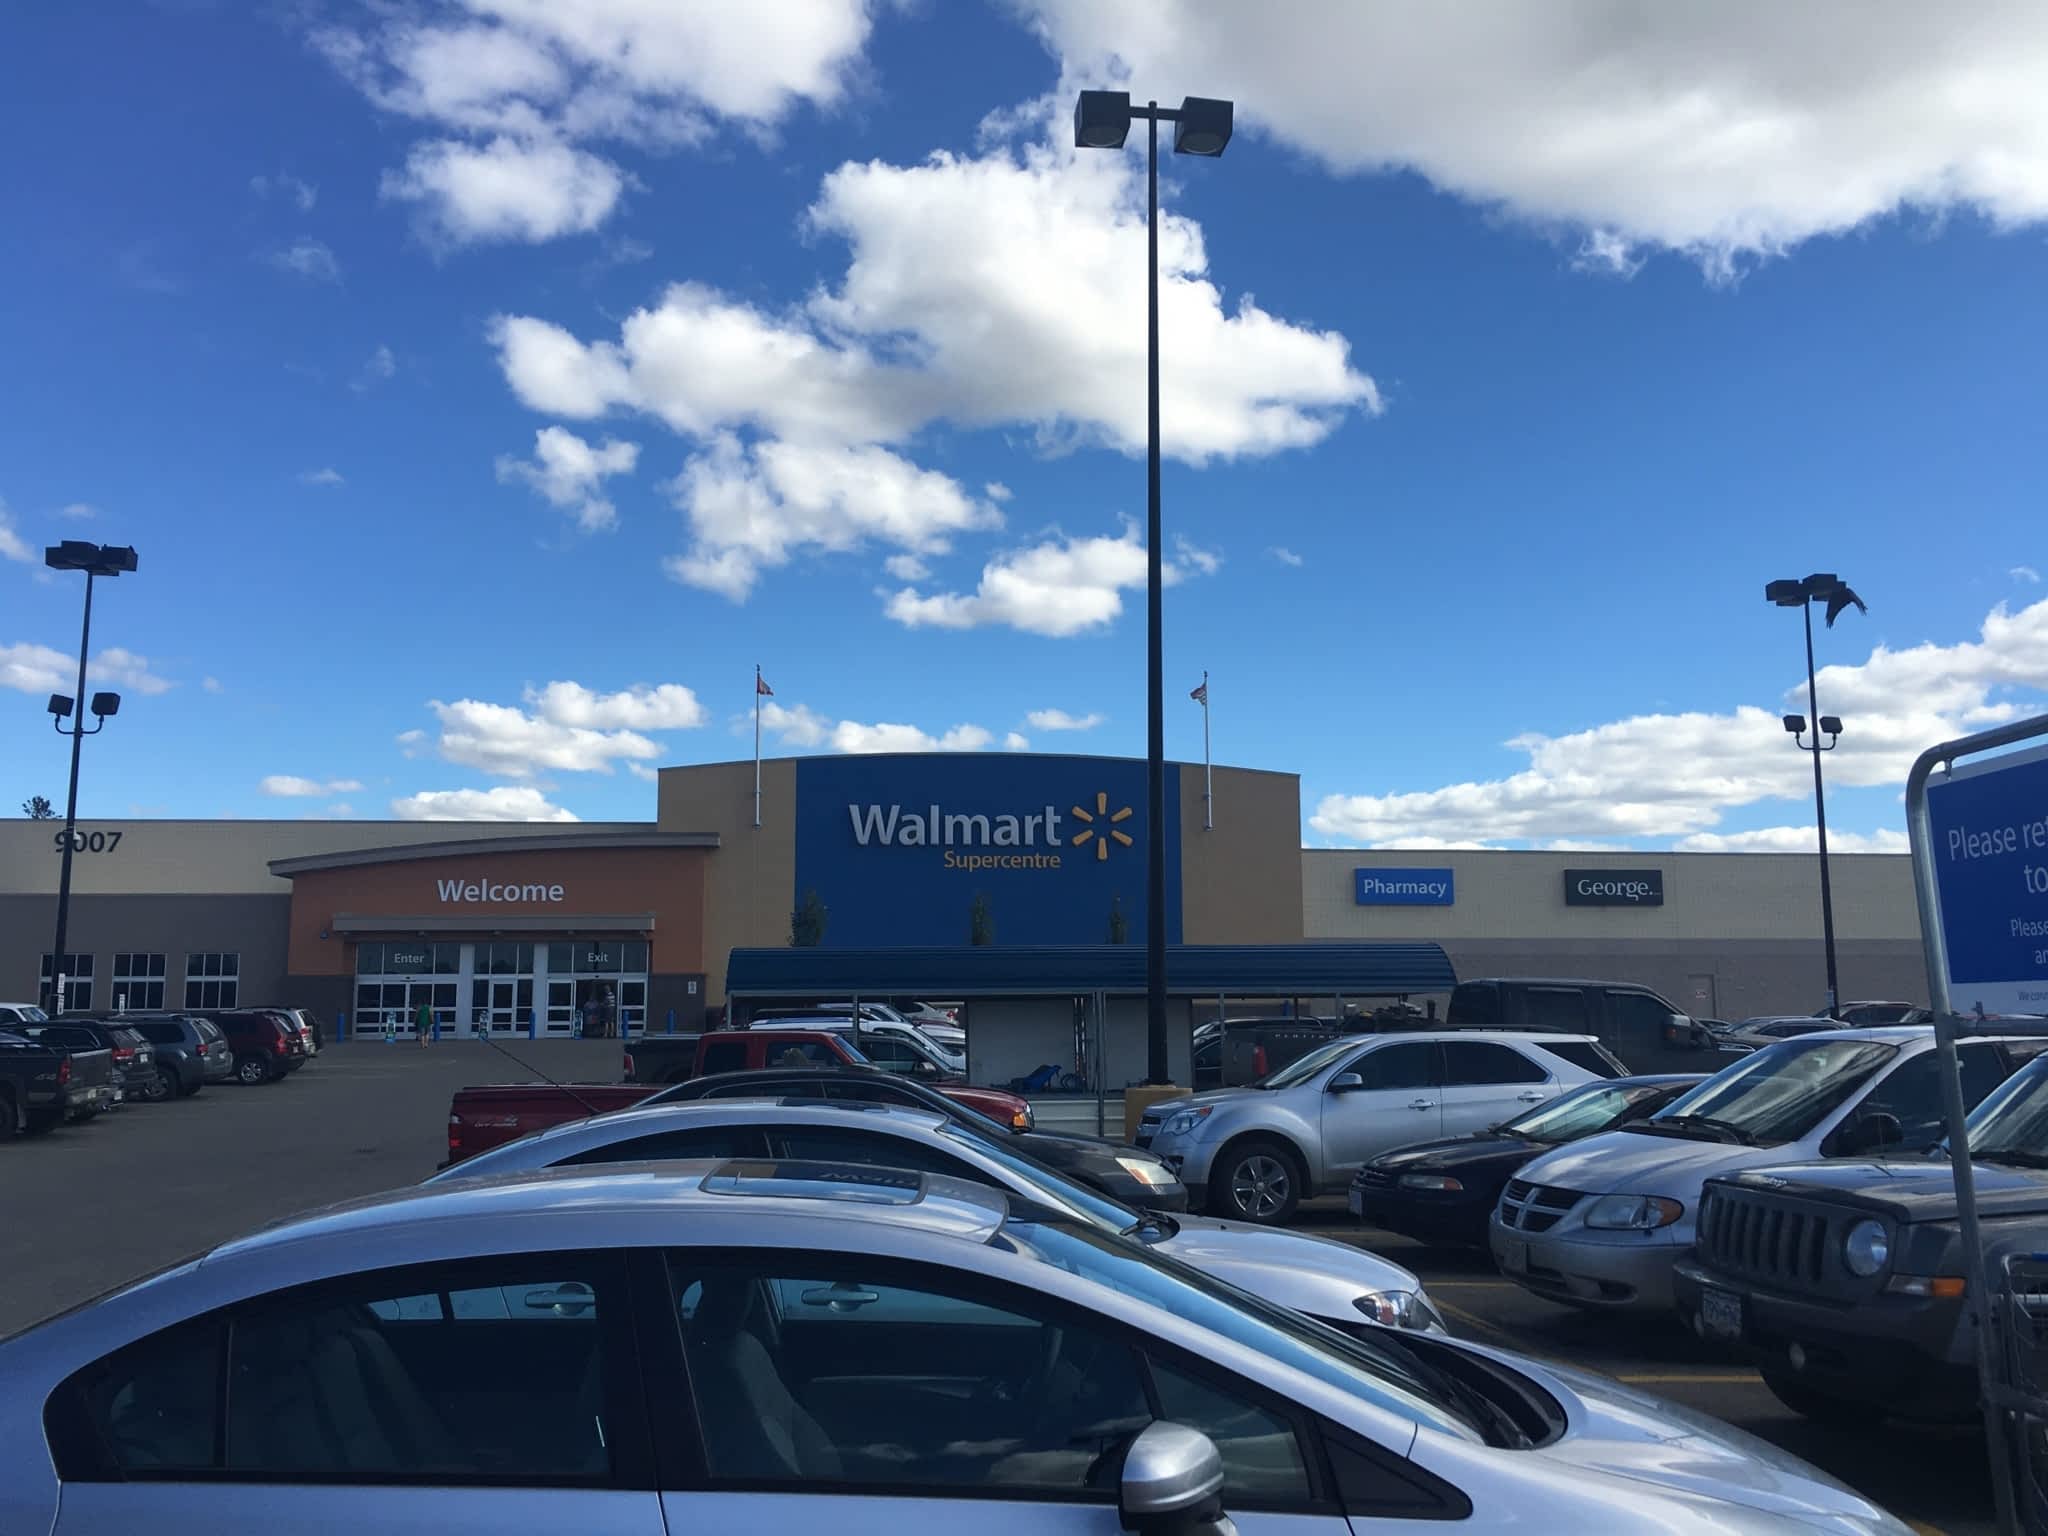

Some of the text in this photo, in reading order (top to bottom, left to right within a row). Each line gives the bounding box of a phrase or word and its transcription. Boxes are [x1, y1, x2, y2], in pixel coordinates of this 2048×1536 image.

[848, 804, 1062, 846] Walmart
[54, 831, 123, 853] 9007
[1947, 825, 2017, 862] Please
[943, 850, 1062, 872] Supercentre
[1363, 879, 1448, 899] Pharmacy
[2023, 864, 2048, 894] to
[436, 878, 565, 903] Welcome
[2011, 918, 2048, 937] Please
[393, 952, 425, 965] Enter
[587, 951, 609, 964] Exit
